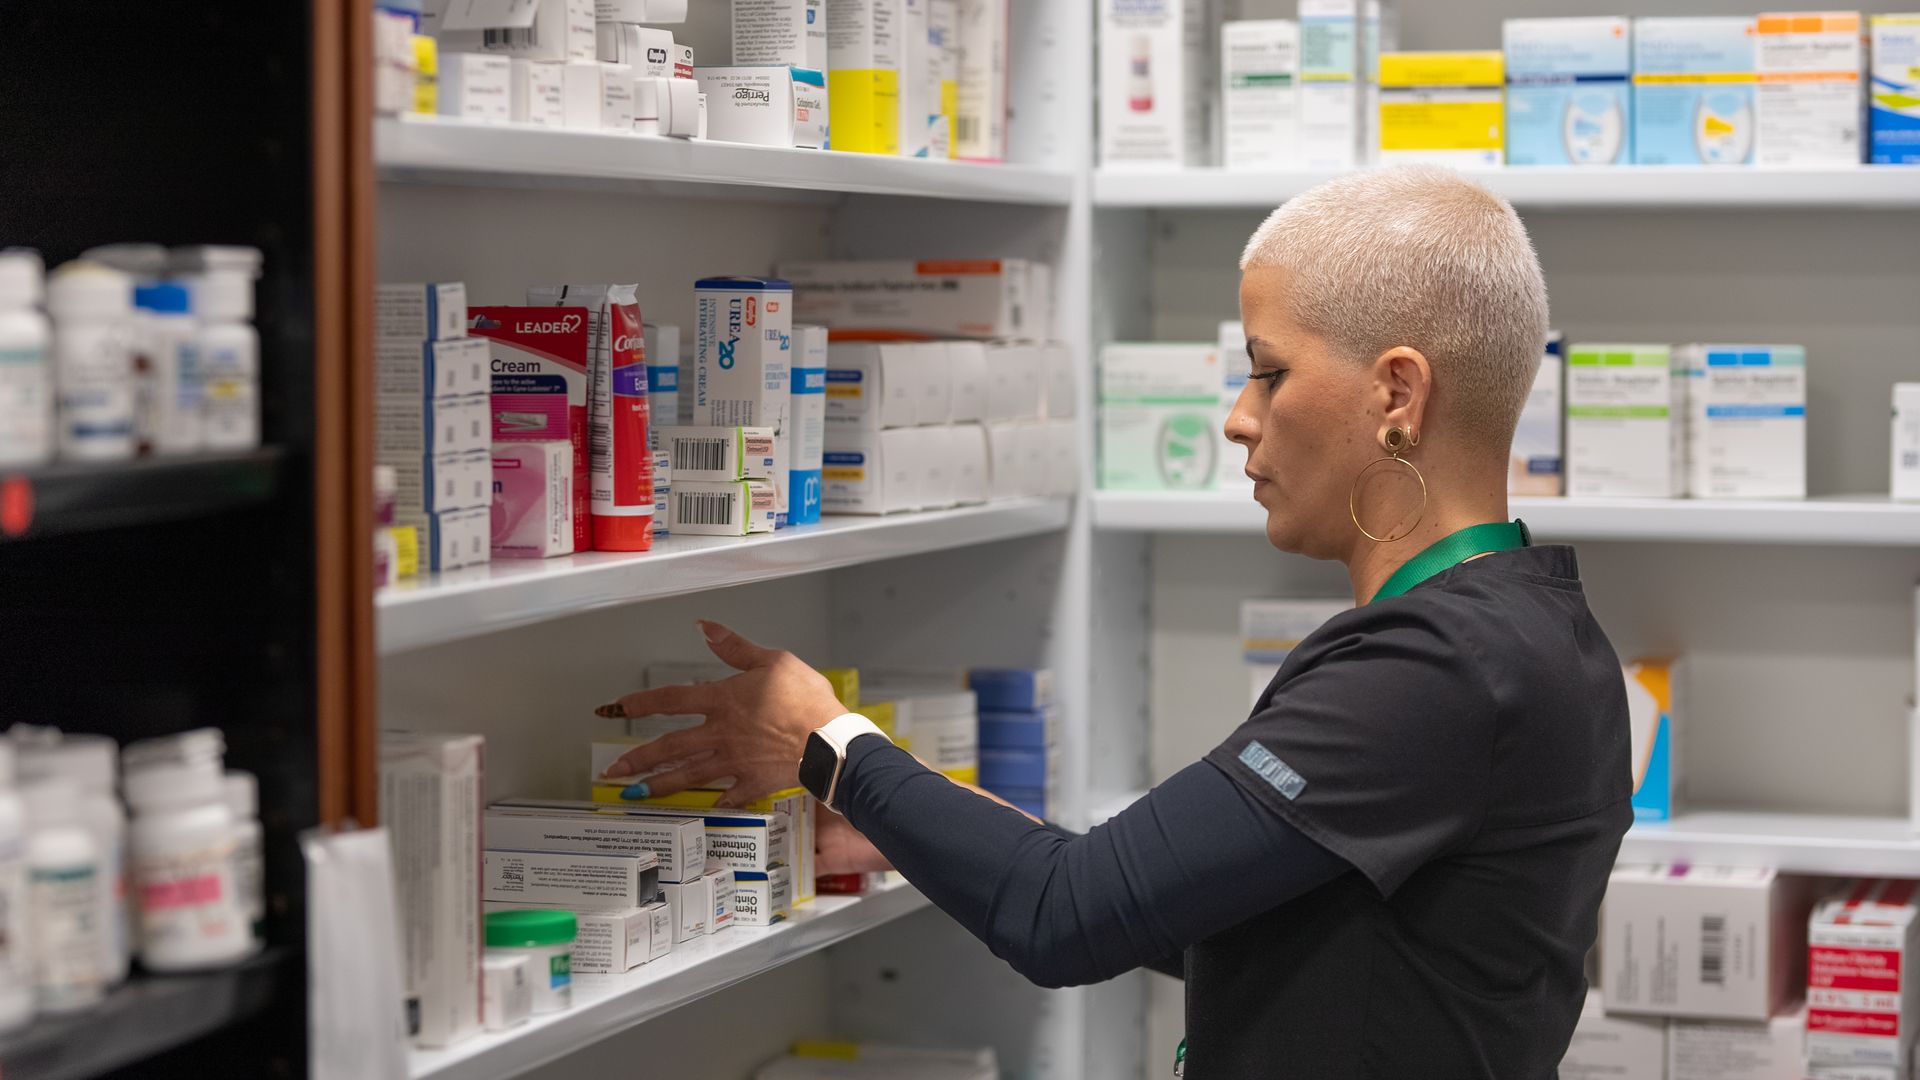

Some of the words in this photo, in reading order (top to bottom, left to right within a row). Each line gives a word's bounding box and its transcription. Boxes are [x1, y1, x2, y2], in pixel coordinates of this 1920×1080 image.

[735, 88, 770, 103] Perrigo
[515, 321, 571, 334] LEADER
[708, 299, 717, 347] INTENSIVE
[729, 298, 742, 346] UREA
[698, 299, 708, 364] HYDRATING
[718, 341, 735, 370] 20
[490, 359, 542, 373] Cream
[698, 366, 708, 407] CREAM
[712, 840, 757, 851] Ointment
[706, 850, 757, 861] Hemorrhoi
[735, 896, 758, 906] Oint
